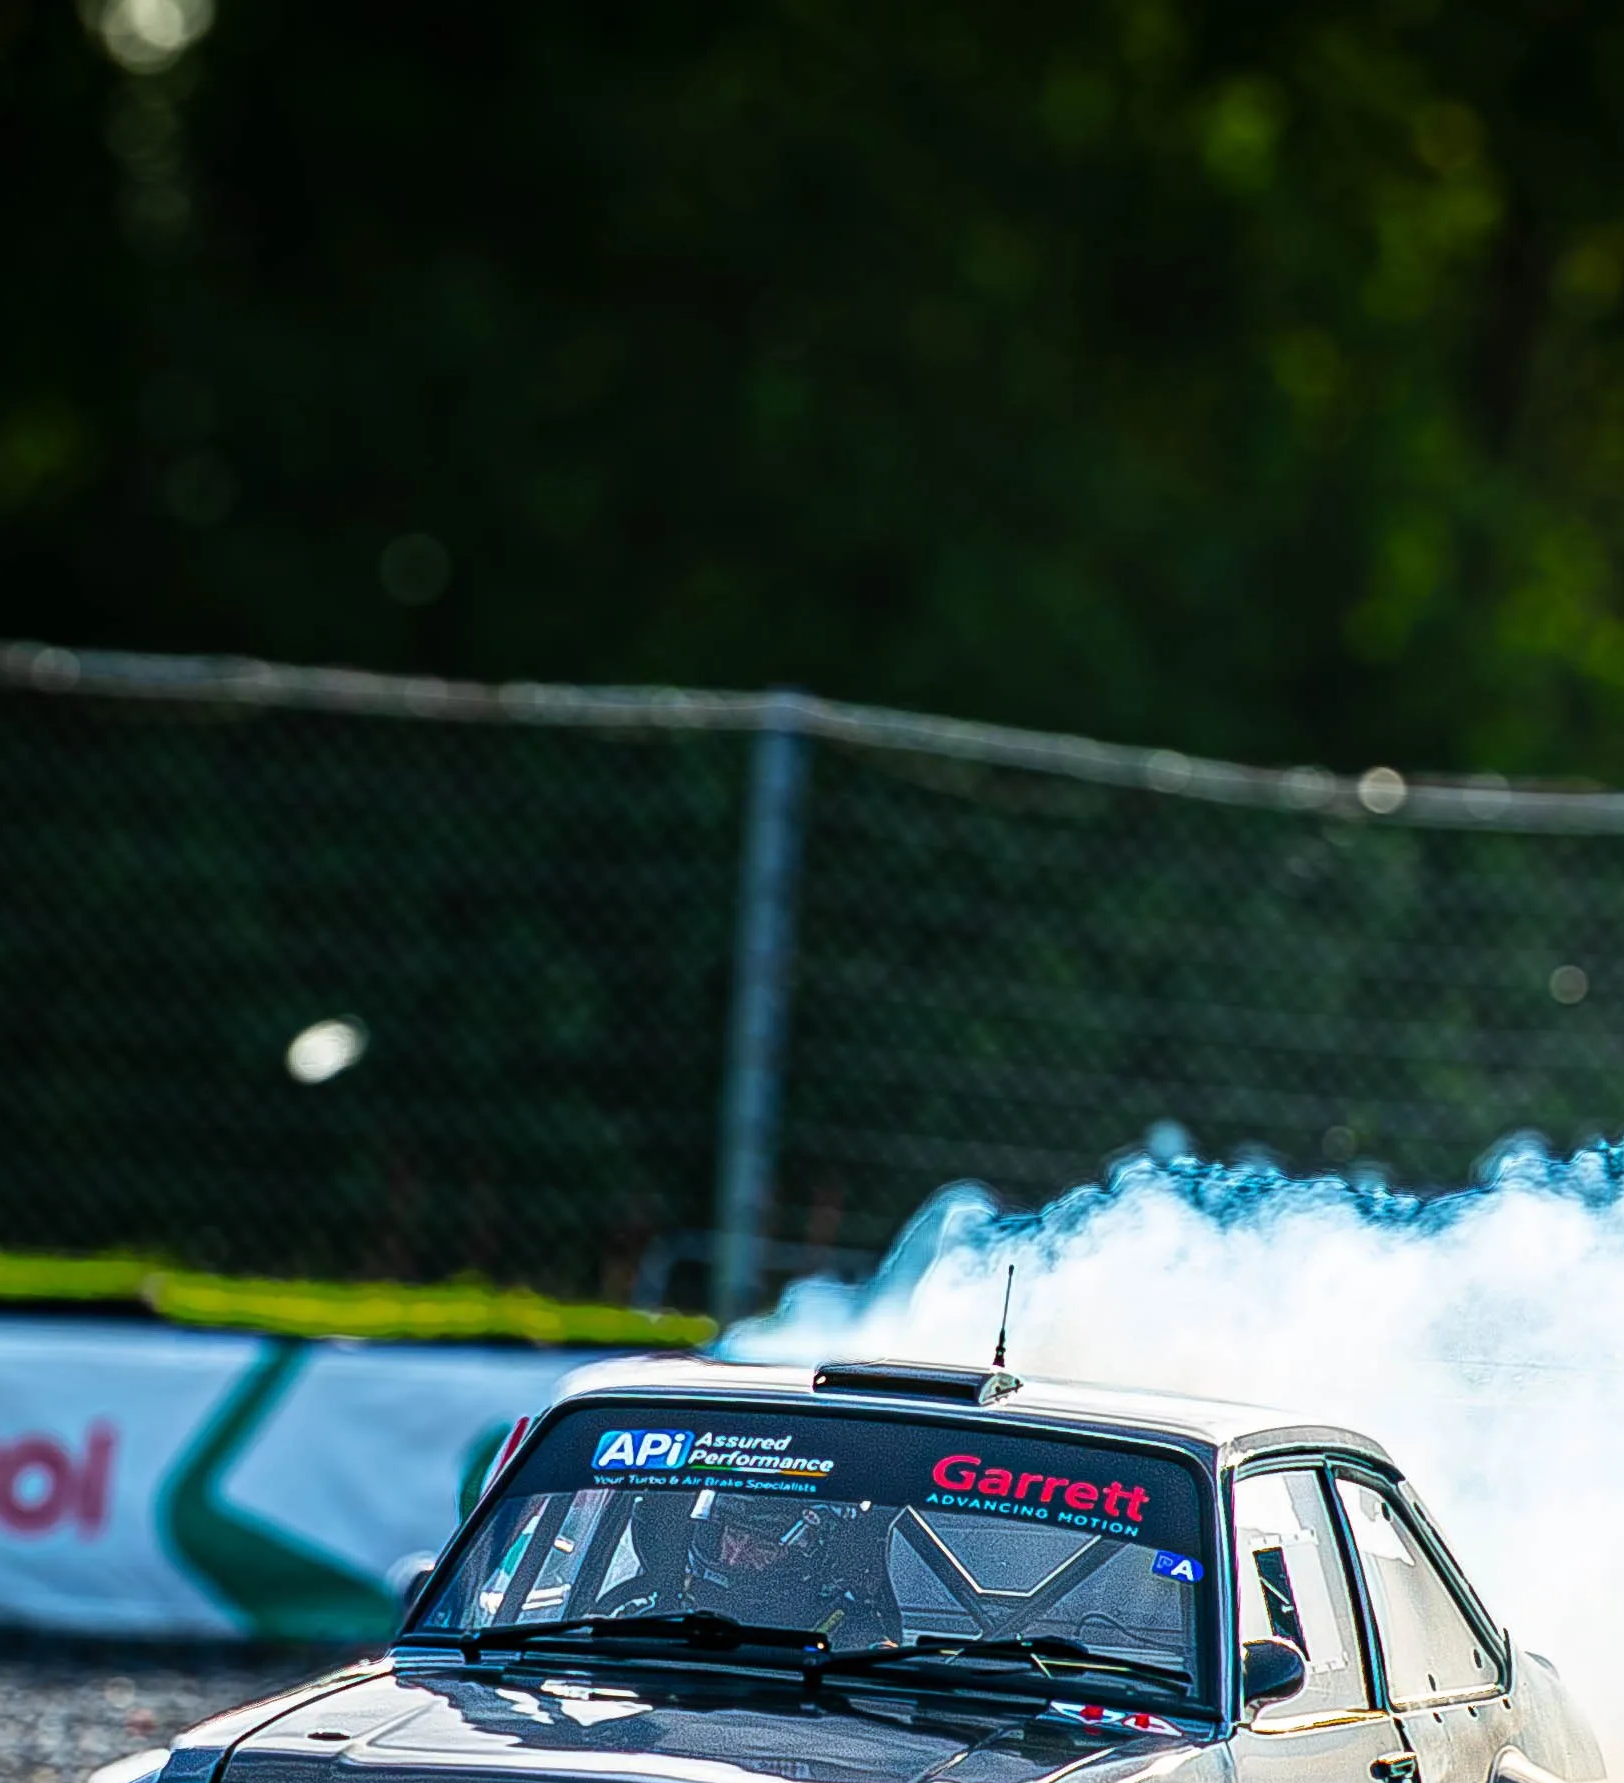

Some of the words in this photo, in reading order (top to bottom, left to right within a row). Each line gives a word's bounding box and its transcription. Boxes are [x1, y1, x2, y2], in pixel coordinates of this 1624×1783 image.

[694, 1432, 793, 1451] Assured
[688, 1450, 835, 1473] Performance
[593, 1474, 625, 1485] Your
[629, 1474, 667, 1485] Turbo
[682, 1476, 702, 1486] Air
[704, 1477, 744, 1488] Brake
[745, 1479, 817, 1493] Specialists
[932, 1455, 1150, 1522] Garrett
[926, 1493, 1049, 1520] ADVANCING
[1058, 1511, 1140, 1538] MOTION
